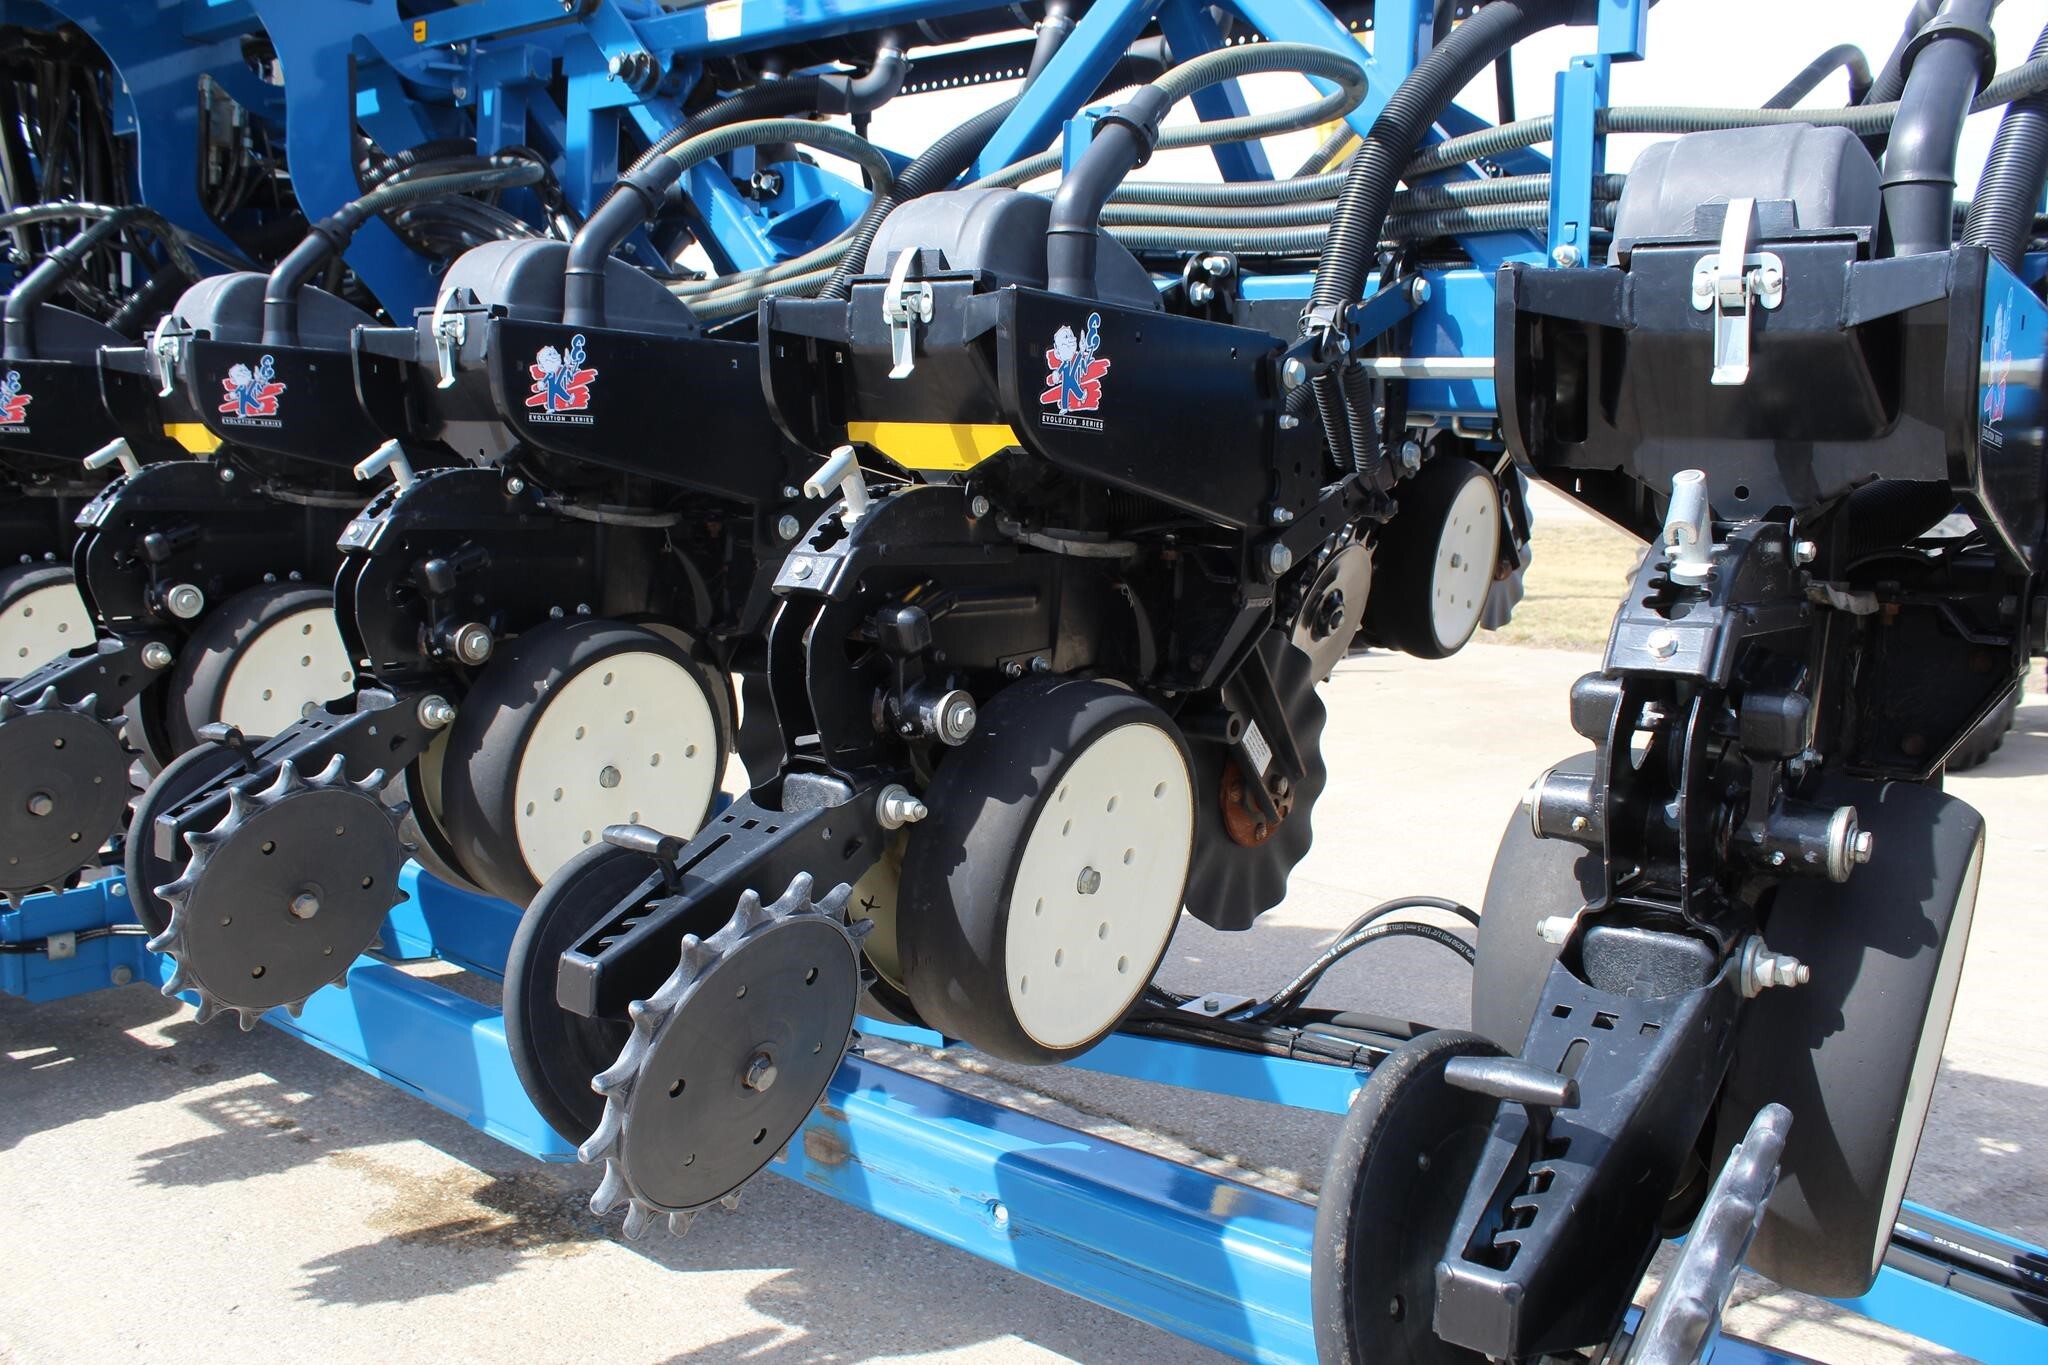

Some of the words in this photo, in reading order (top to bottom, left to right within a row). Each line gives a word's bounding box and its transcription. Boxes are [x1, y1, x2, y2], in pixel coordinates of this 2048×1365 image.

[528, 414, 566, 422] EVOLUTION
[1042, 415, 1078, 425] EVOLUTION
[1081, 419, 1103, 429] SERIES
